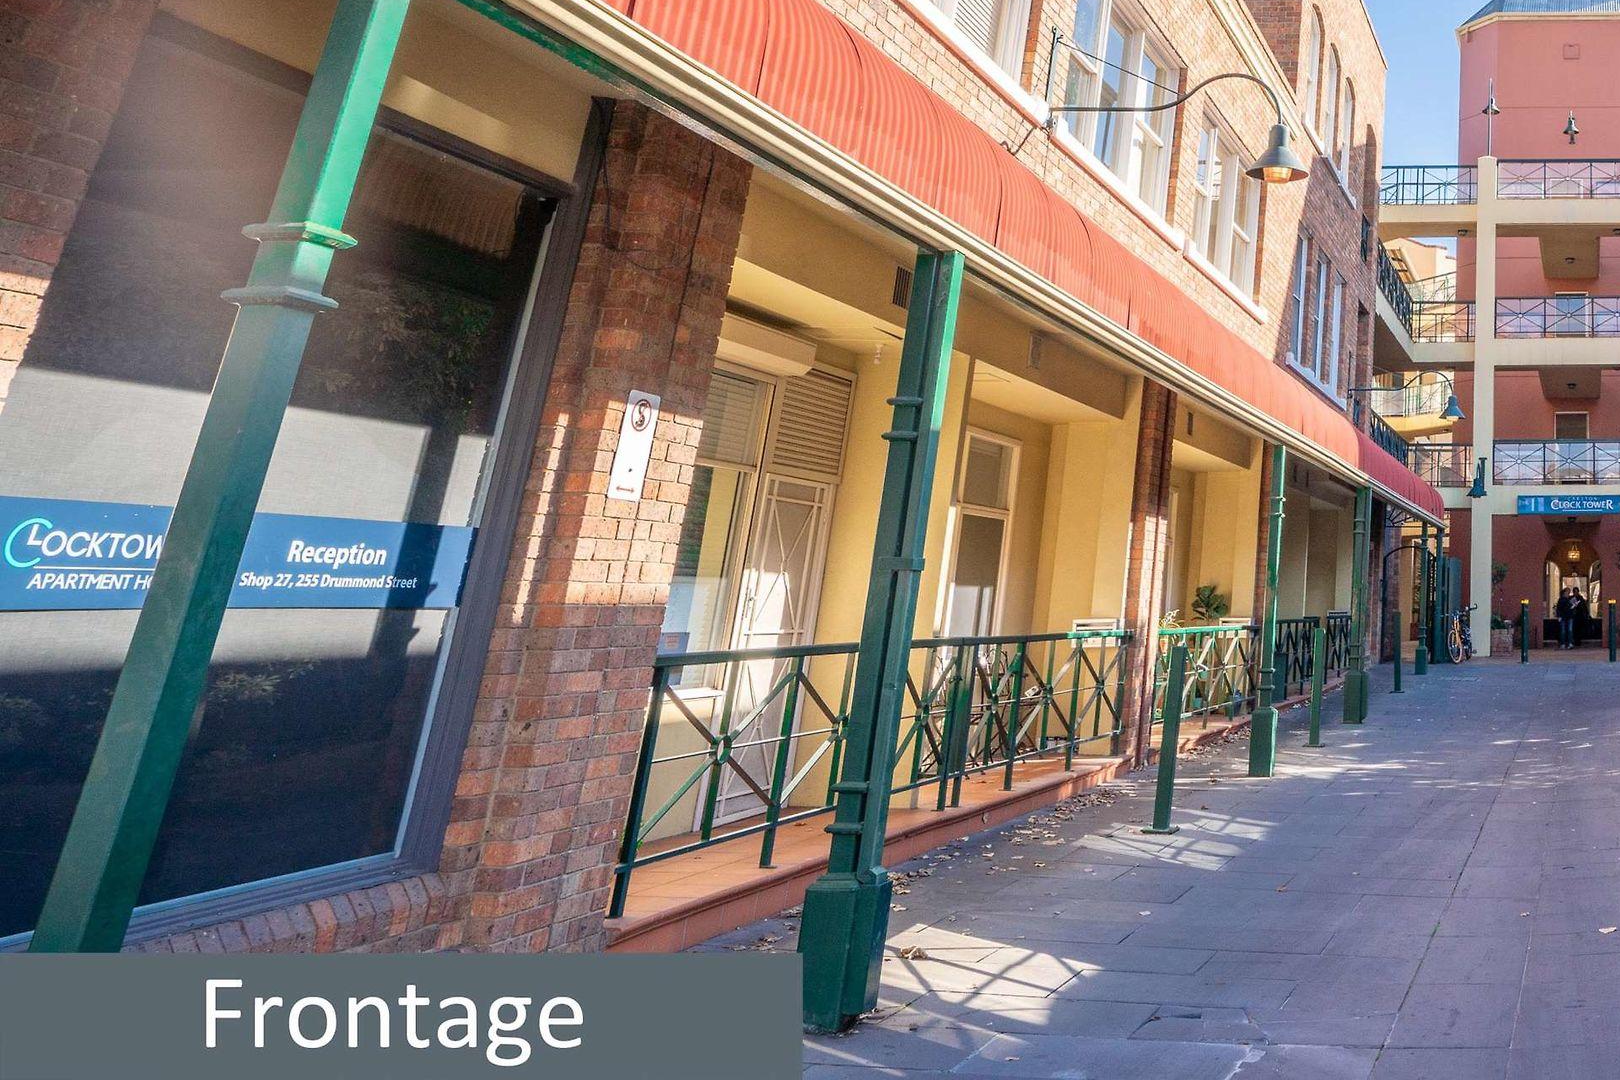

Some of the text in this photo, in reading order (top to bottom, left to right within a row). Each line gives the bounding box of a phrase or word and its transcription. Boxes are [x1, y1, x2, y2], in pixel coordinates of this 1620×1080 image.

[1551, 500, 1614, 510] CLOCK TOWER
[286, 539, 387, 569] Reception
[26, 573, 135, 590] APARTMENT
[239, 572, 418, 590] Shop 27, 255 Drummond Street
